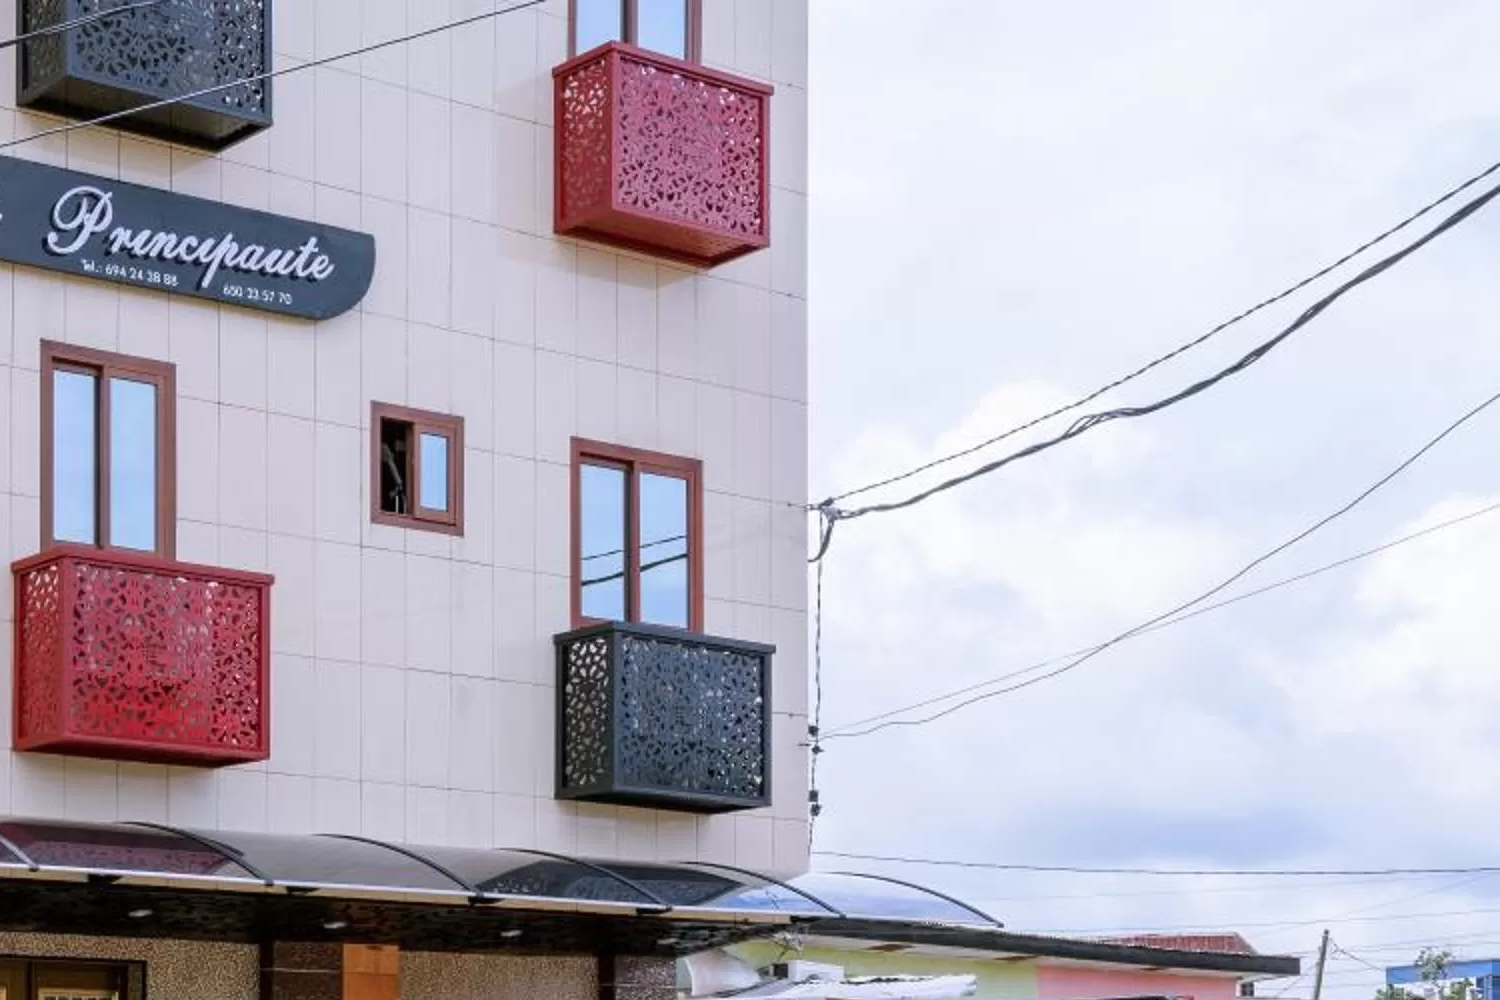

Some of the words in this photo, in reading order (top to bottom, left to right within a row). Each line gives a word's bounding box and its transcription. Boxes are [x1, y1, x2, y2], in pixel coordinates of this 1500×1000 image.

[105, 264, 127, 277] 694
[129, 267, 143, 281] 24
[147, 269, 161, 283] 38
[278, 291, 293, 305] 70
